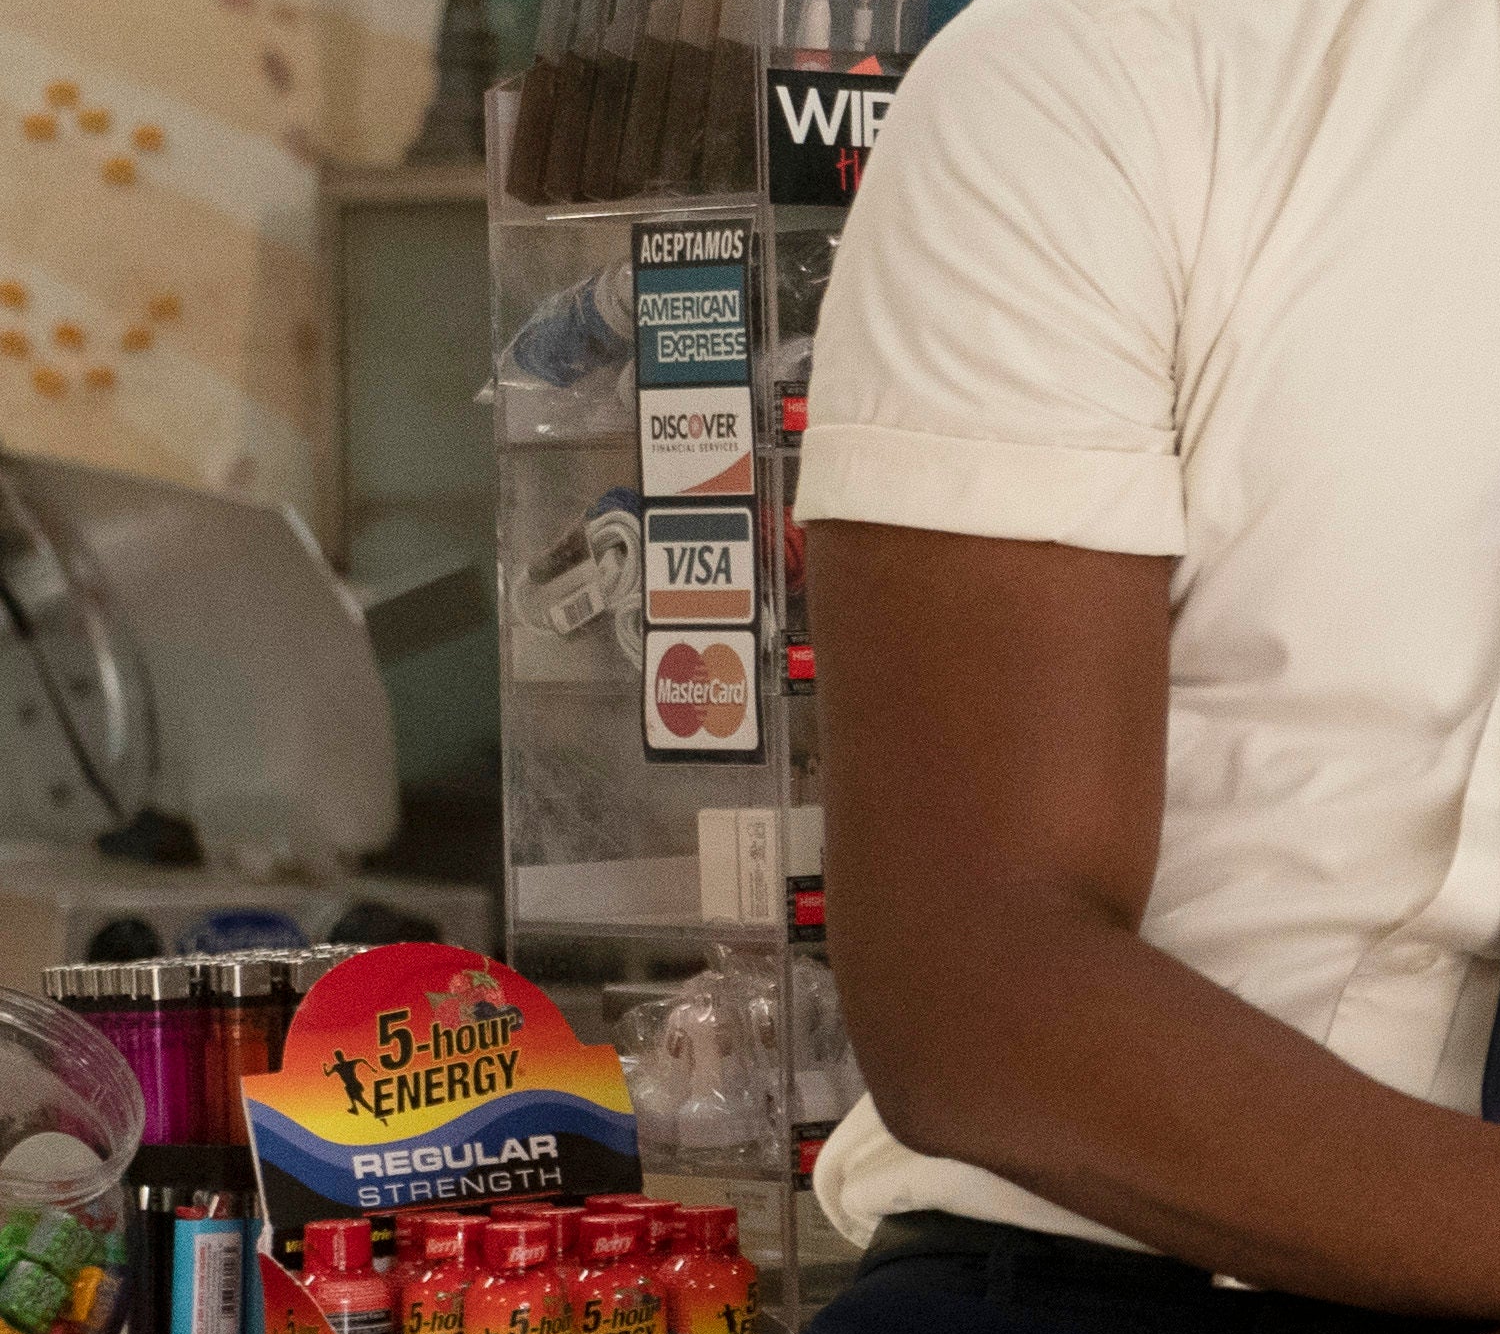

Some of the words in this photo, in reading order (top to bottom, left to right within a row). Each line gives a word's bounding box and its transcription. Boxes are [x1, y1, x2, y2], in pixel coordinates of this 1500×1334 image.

[642, 232, 745, 268] ACEPTAMOS
[639, 290, 742, 327] AMERICAN
[658, 327, 747, 364] EXPRESS
[650, 413, 738, 442] DISCOVER
[664, 548, 734, 587] VISA
[657, 677, 746, 709] MasterCard
[375, 1009, 519, 1071] 5-hour
[372, 1049, 520, 1119] ENERGY
[352, 1133, 559, 1180] REGULAR
[357, 1166, 563, 1208] STRENGTH
[591, 1299, 661, 1334] 5-hour
